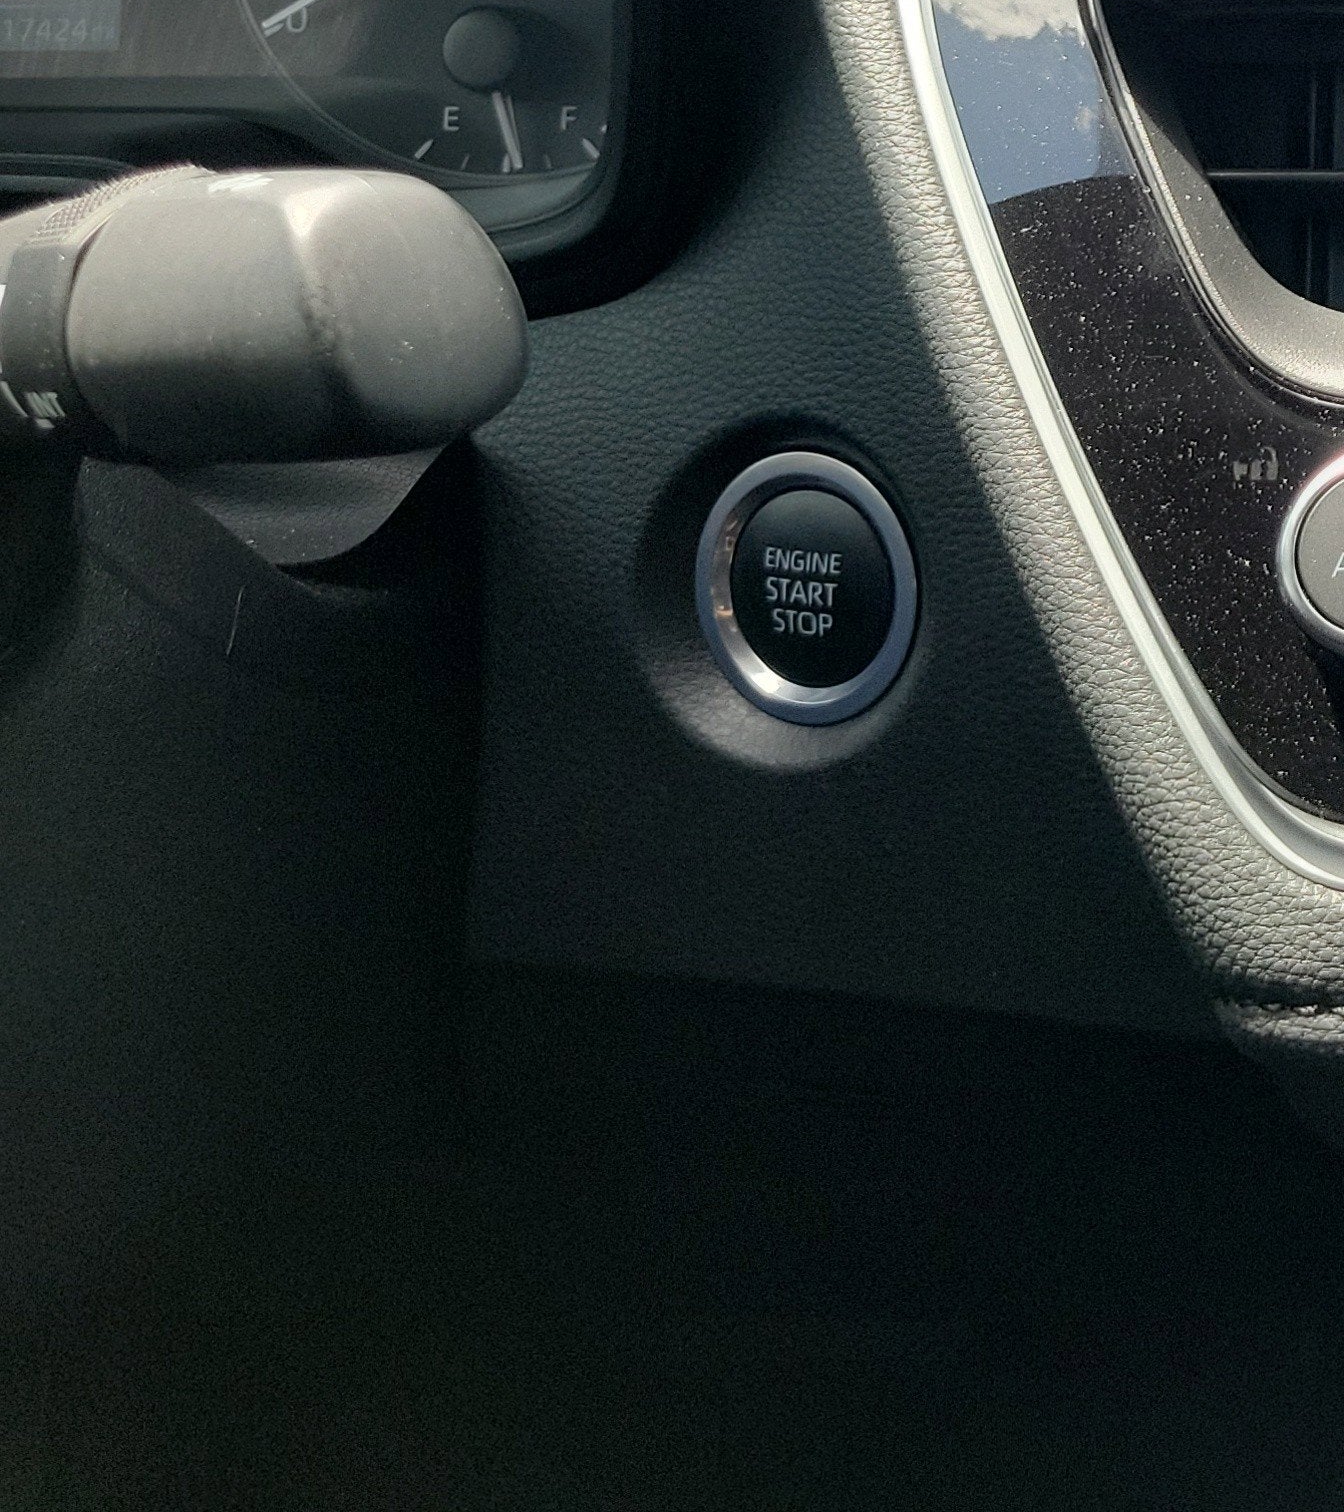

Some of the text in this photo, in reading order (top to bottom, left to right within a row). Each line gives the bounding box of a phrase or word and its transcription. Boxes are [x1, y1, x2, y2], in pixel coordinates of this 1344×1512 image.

[443, 107, 460, 131] E
[560, 107, 577, 131] F
[764, 546, 842, 576] ENGINE
[765, 576, 839, 608] START
[771, 608, 833, 637] STOP
